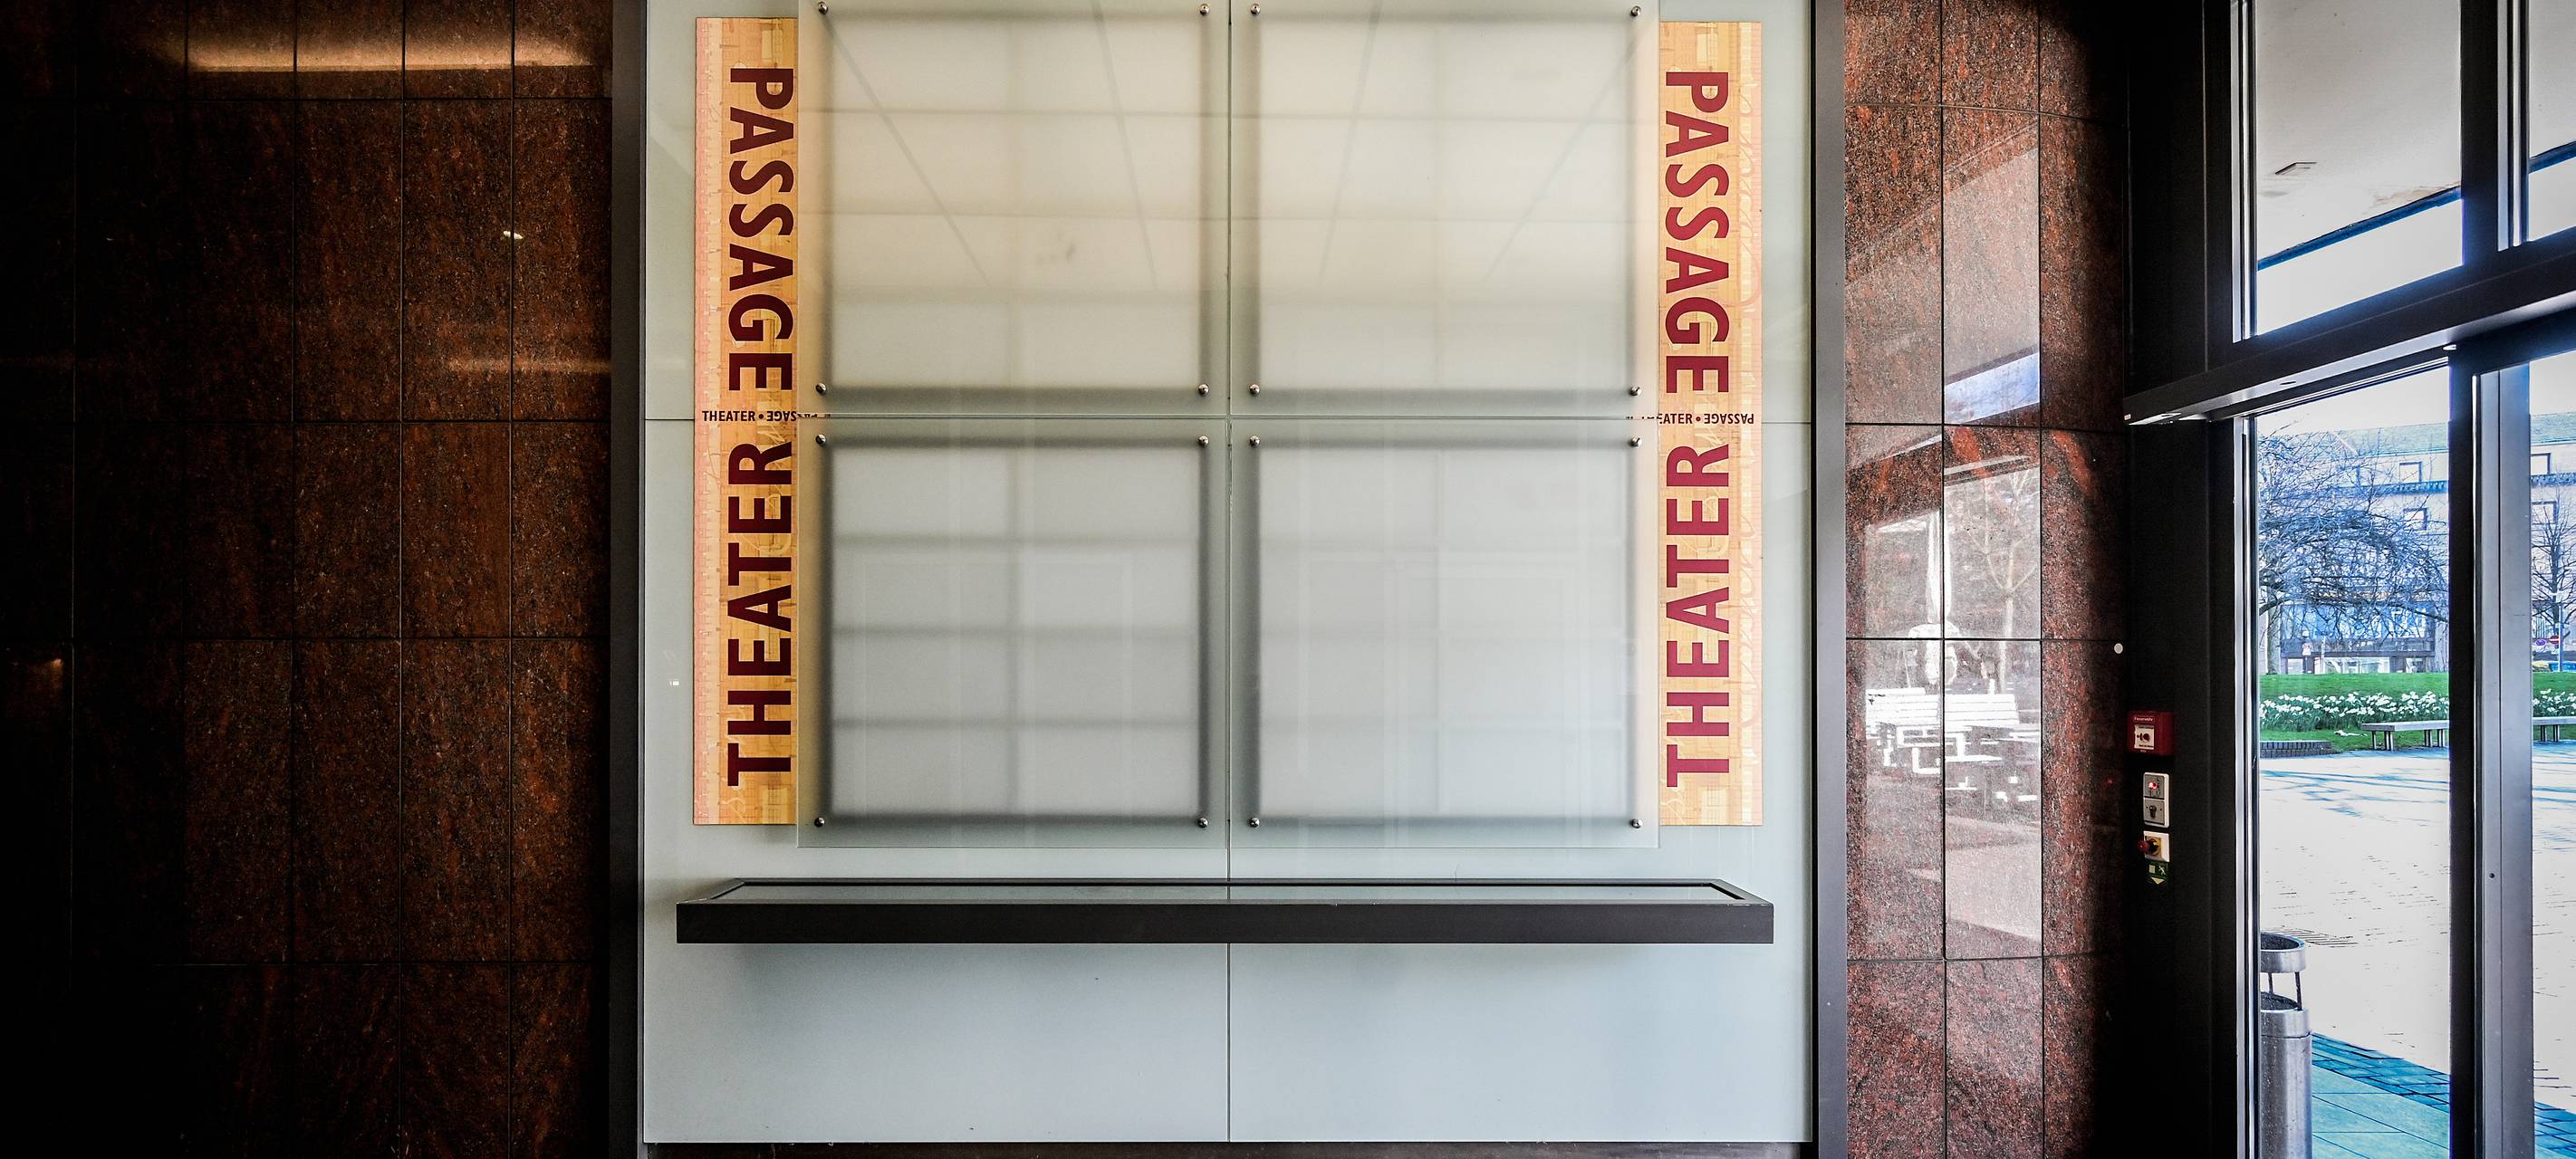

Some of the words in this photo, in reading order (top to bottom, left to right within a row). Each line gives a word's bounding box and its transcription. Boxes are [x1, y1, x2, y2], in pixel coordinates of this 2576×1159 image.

[728, 68, 794, 391] PASSAGE
[1665, 72, 1730, 394] PASSAGE
[702, 410, 755, 422] THEATER
[1704, 413, 1754, 425] PASSAGE
[727, 441, 793, 787] THEATER
[1666, 444, 1730, 788] THEATER
